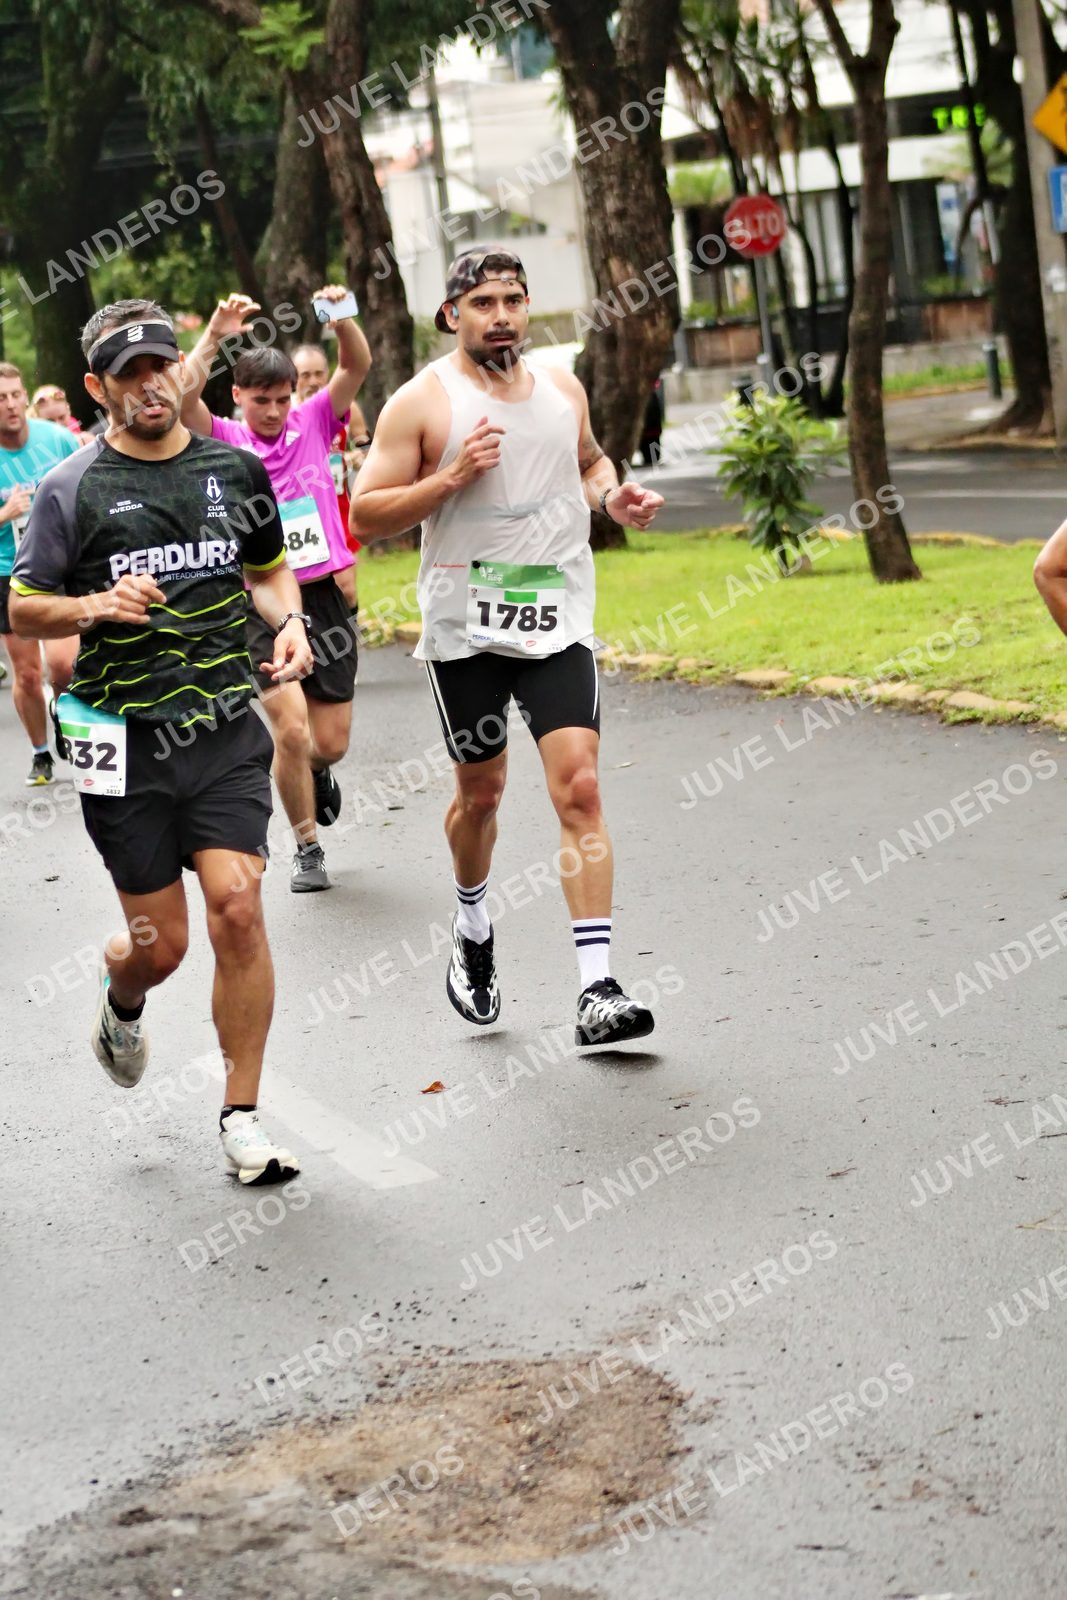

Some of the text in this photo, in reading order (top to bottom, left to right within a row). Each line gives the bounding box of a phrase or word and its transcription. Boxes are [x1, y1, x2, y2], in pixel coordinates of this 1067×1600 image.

[109, 503, 143, 515] SVEDDA
[284, 527, 320, 553] 84
[476, 601, 558, 632] 1785
